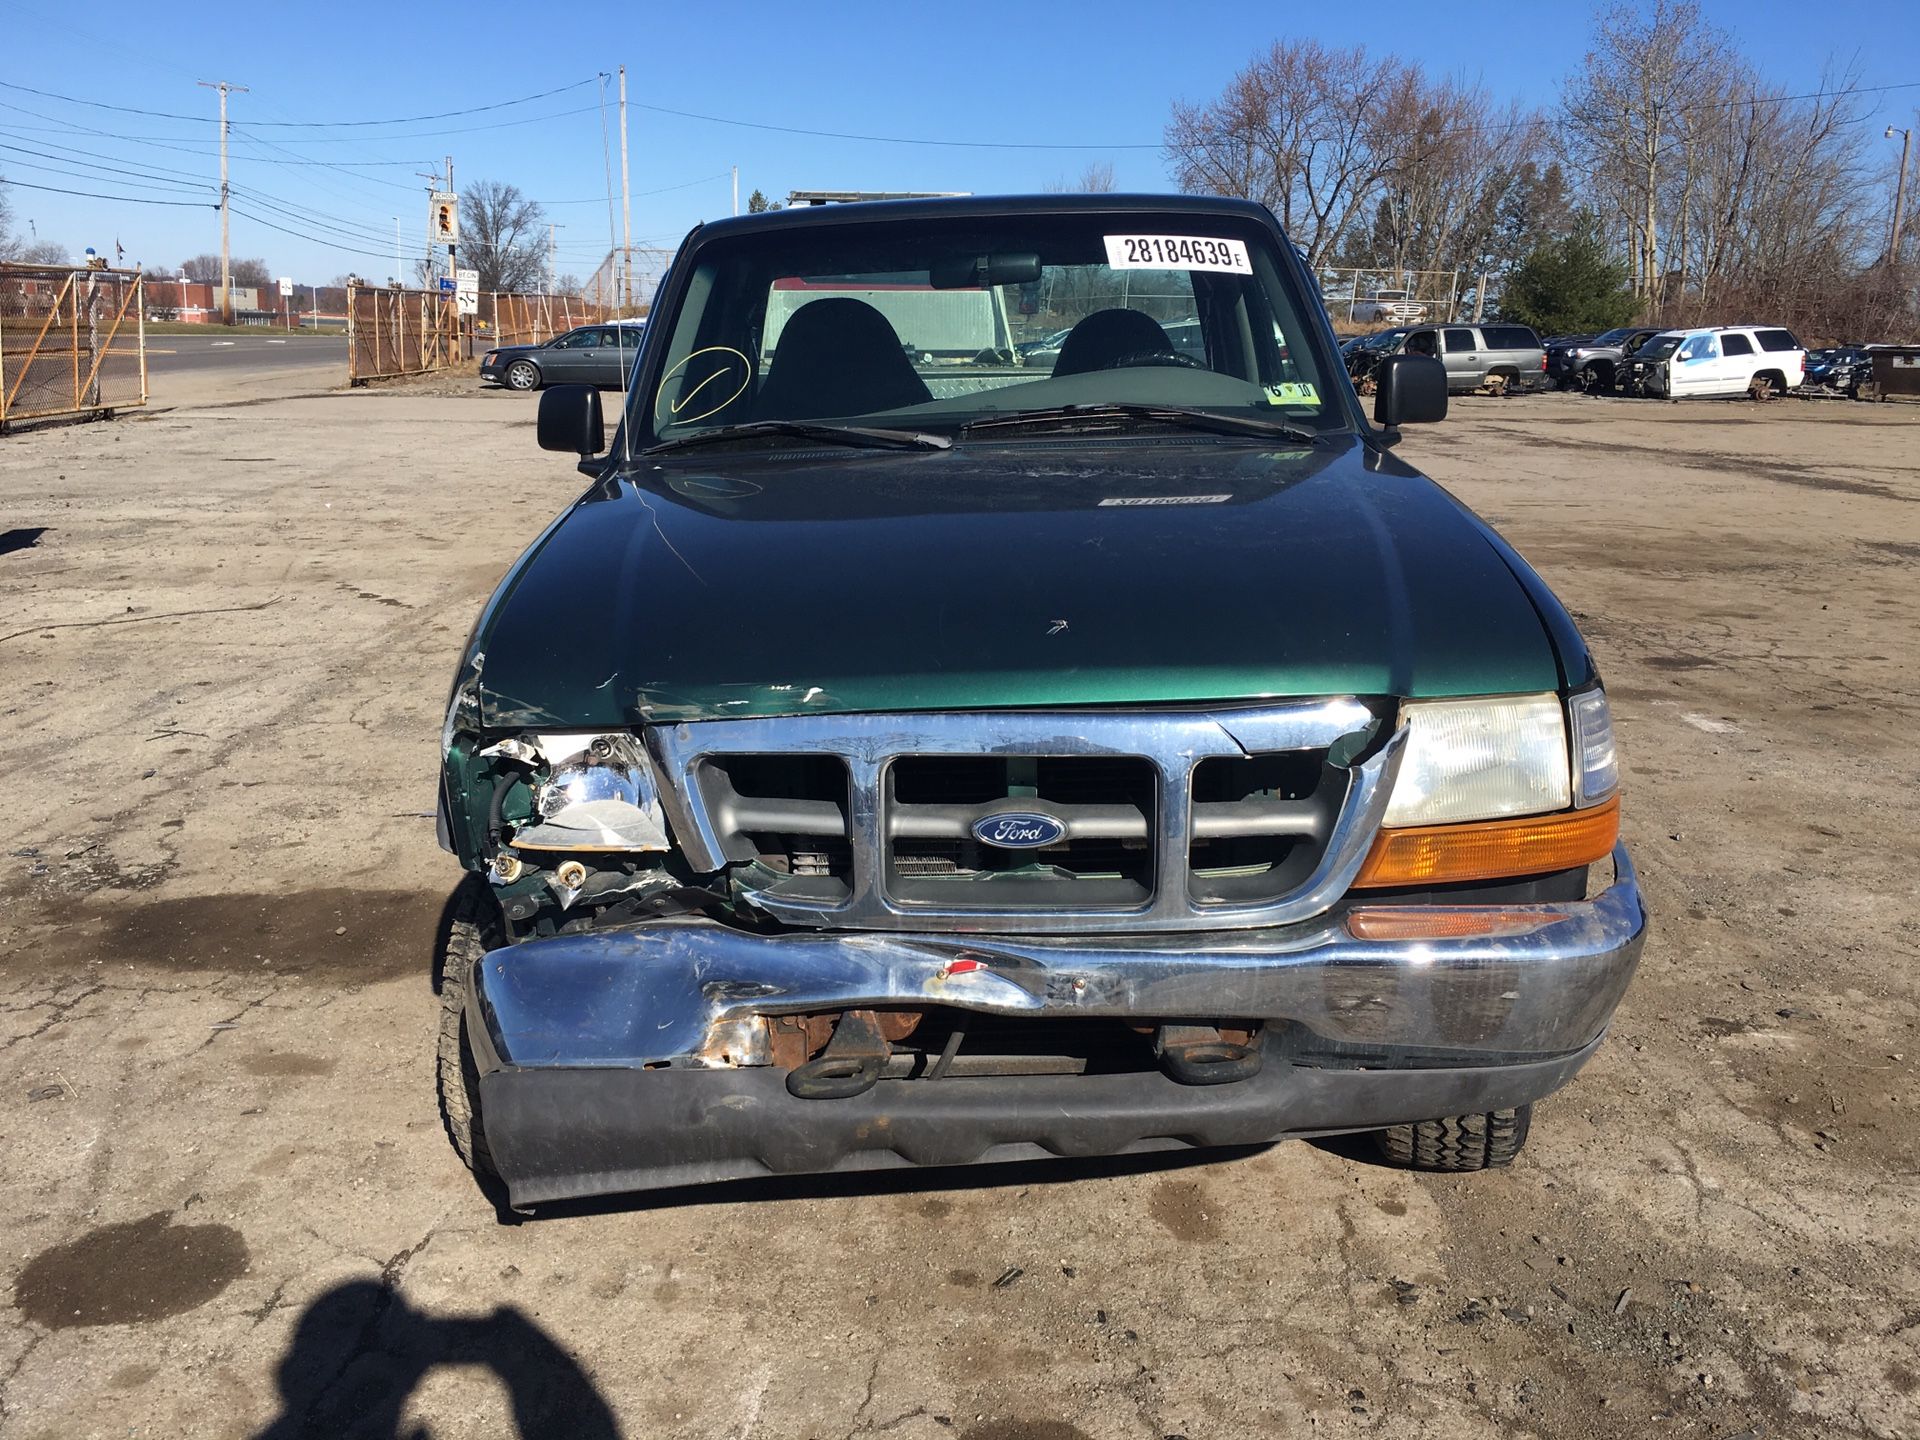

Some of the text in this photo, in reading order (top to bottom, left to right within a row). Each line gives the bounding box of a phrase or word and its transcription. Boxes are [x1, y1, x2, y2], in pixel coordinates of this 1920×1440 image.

[1124, 239, 1232, 266] 28184639
[1234, 253, 1244, 267] E
[1298, 384, 1312, 397] 10
[994, 820, 1044, 840] Ford
